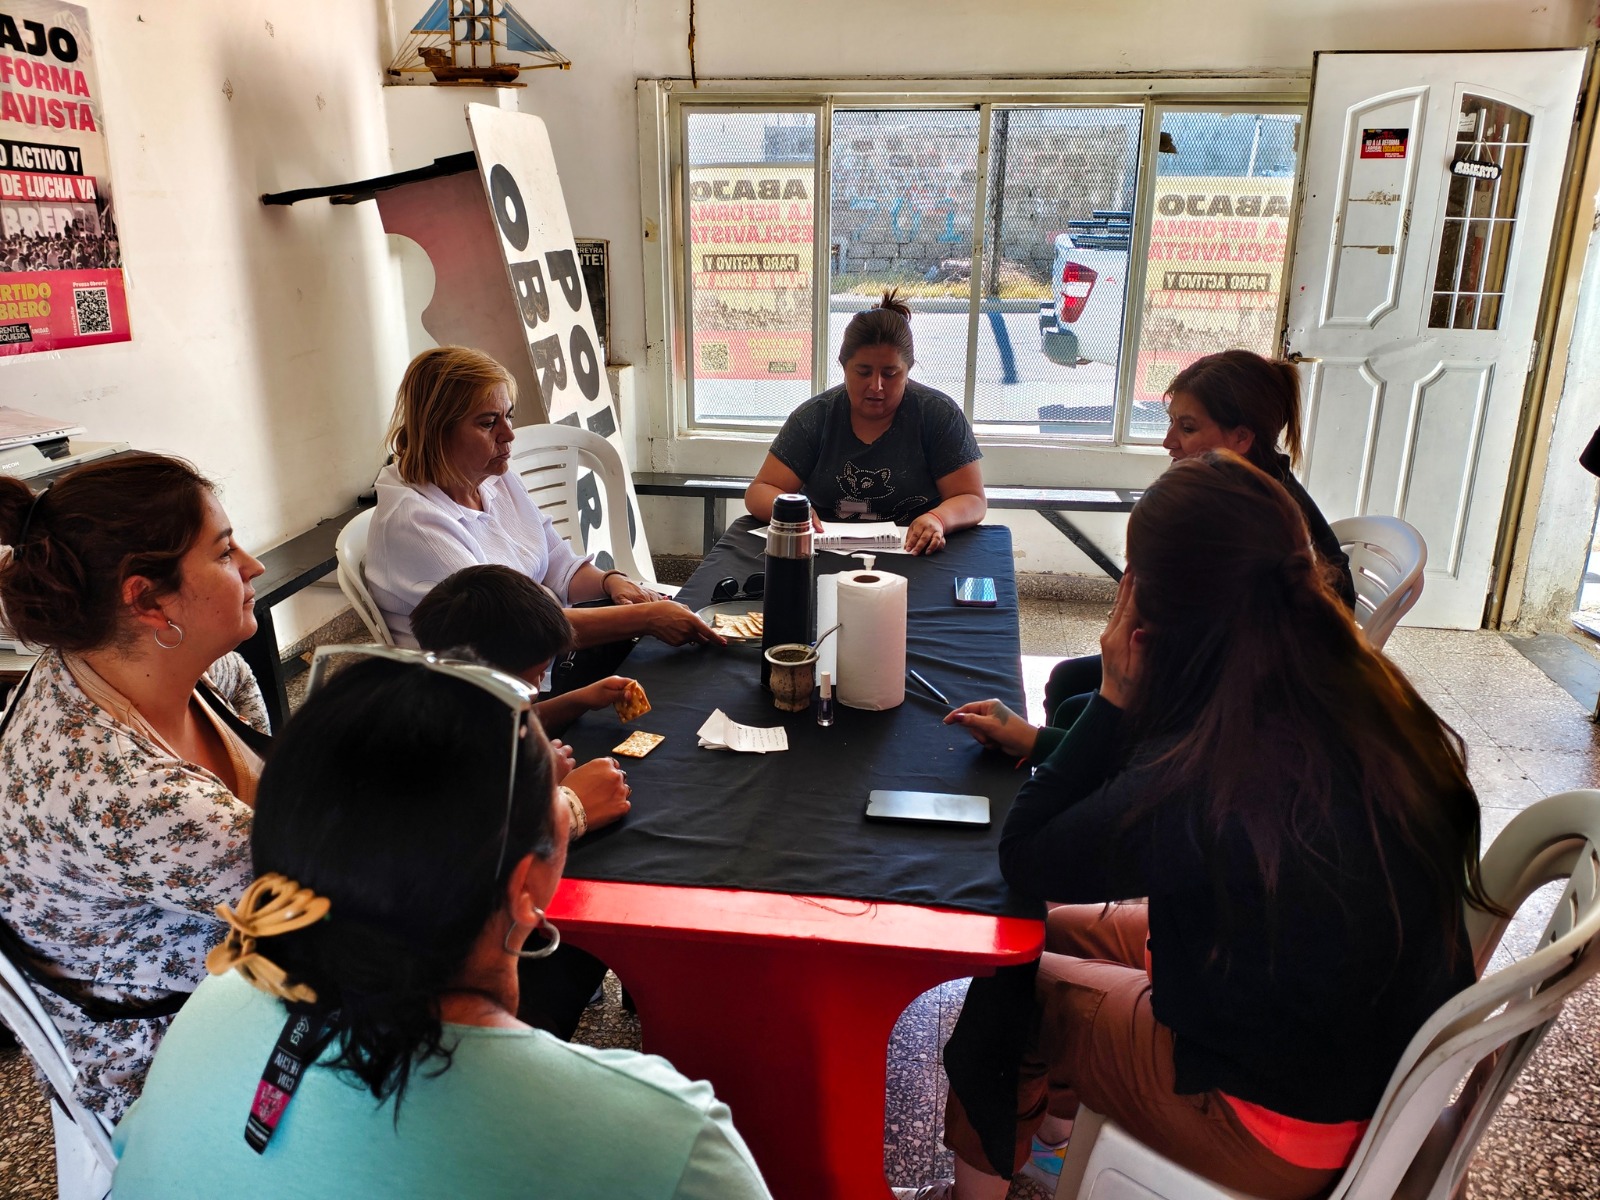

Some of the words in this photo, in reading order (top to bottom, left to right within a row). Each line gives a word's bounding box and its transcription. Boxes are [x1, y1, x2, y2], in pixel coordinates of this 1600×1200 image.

[0, 13, 78, 63] AJO
[0, 55, 90, 98] FORMA
[0, 90, 96, 132] AVISTA
[12, 146, 66, 171] ACTIVO
[69, 151, 78, 171] Y
[1454, 161, 1498, 179] ABIERTO
[2, 174, 23, 196] DE
[25, 176, 75, 198] LUCHA
[77, 178, 96, 199] YA
[2, 461, 19, 470] RICOH
